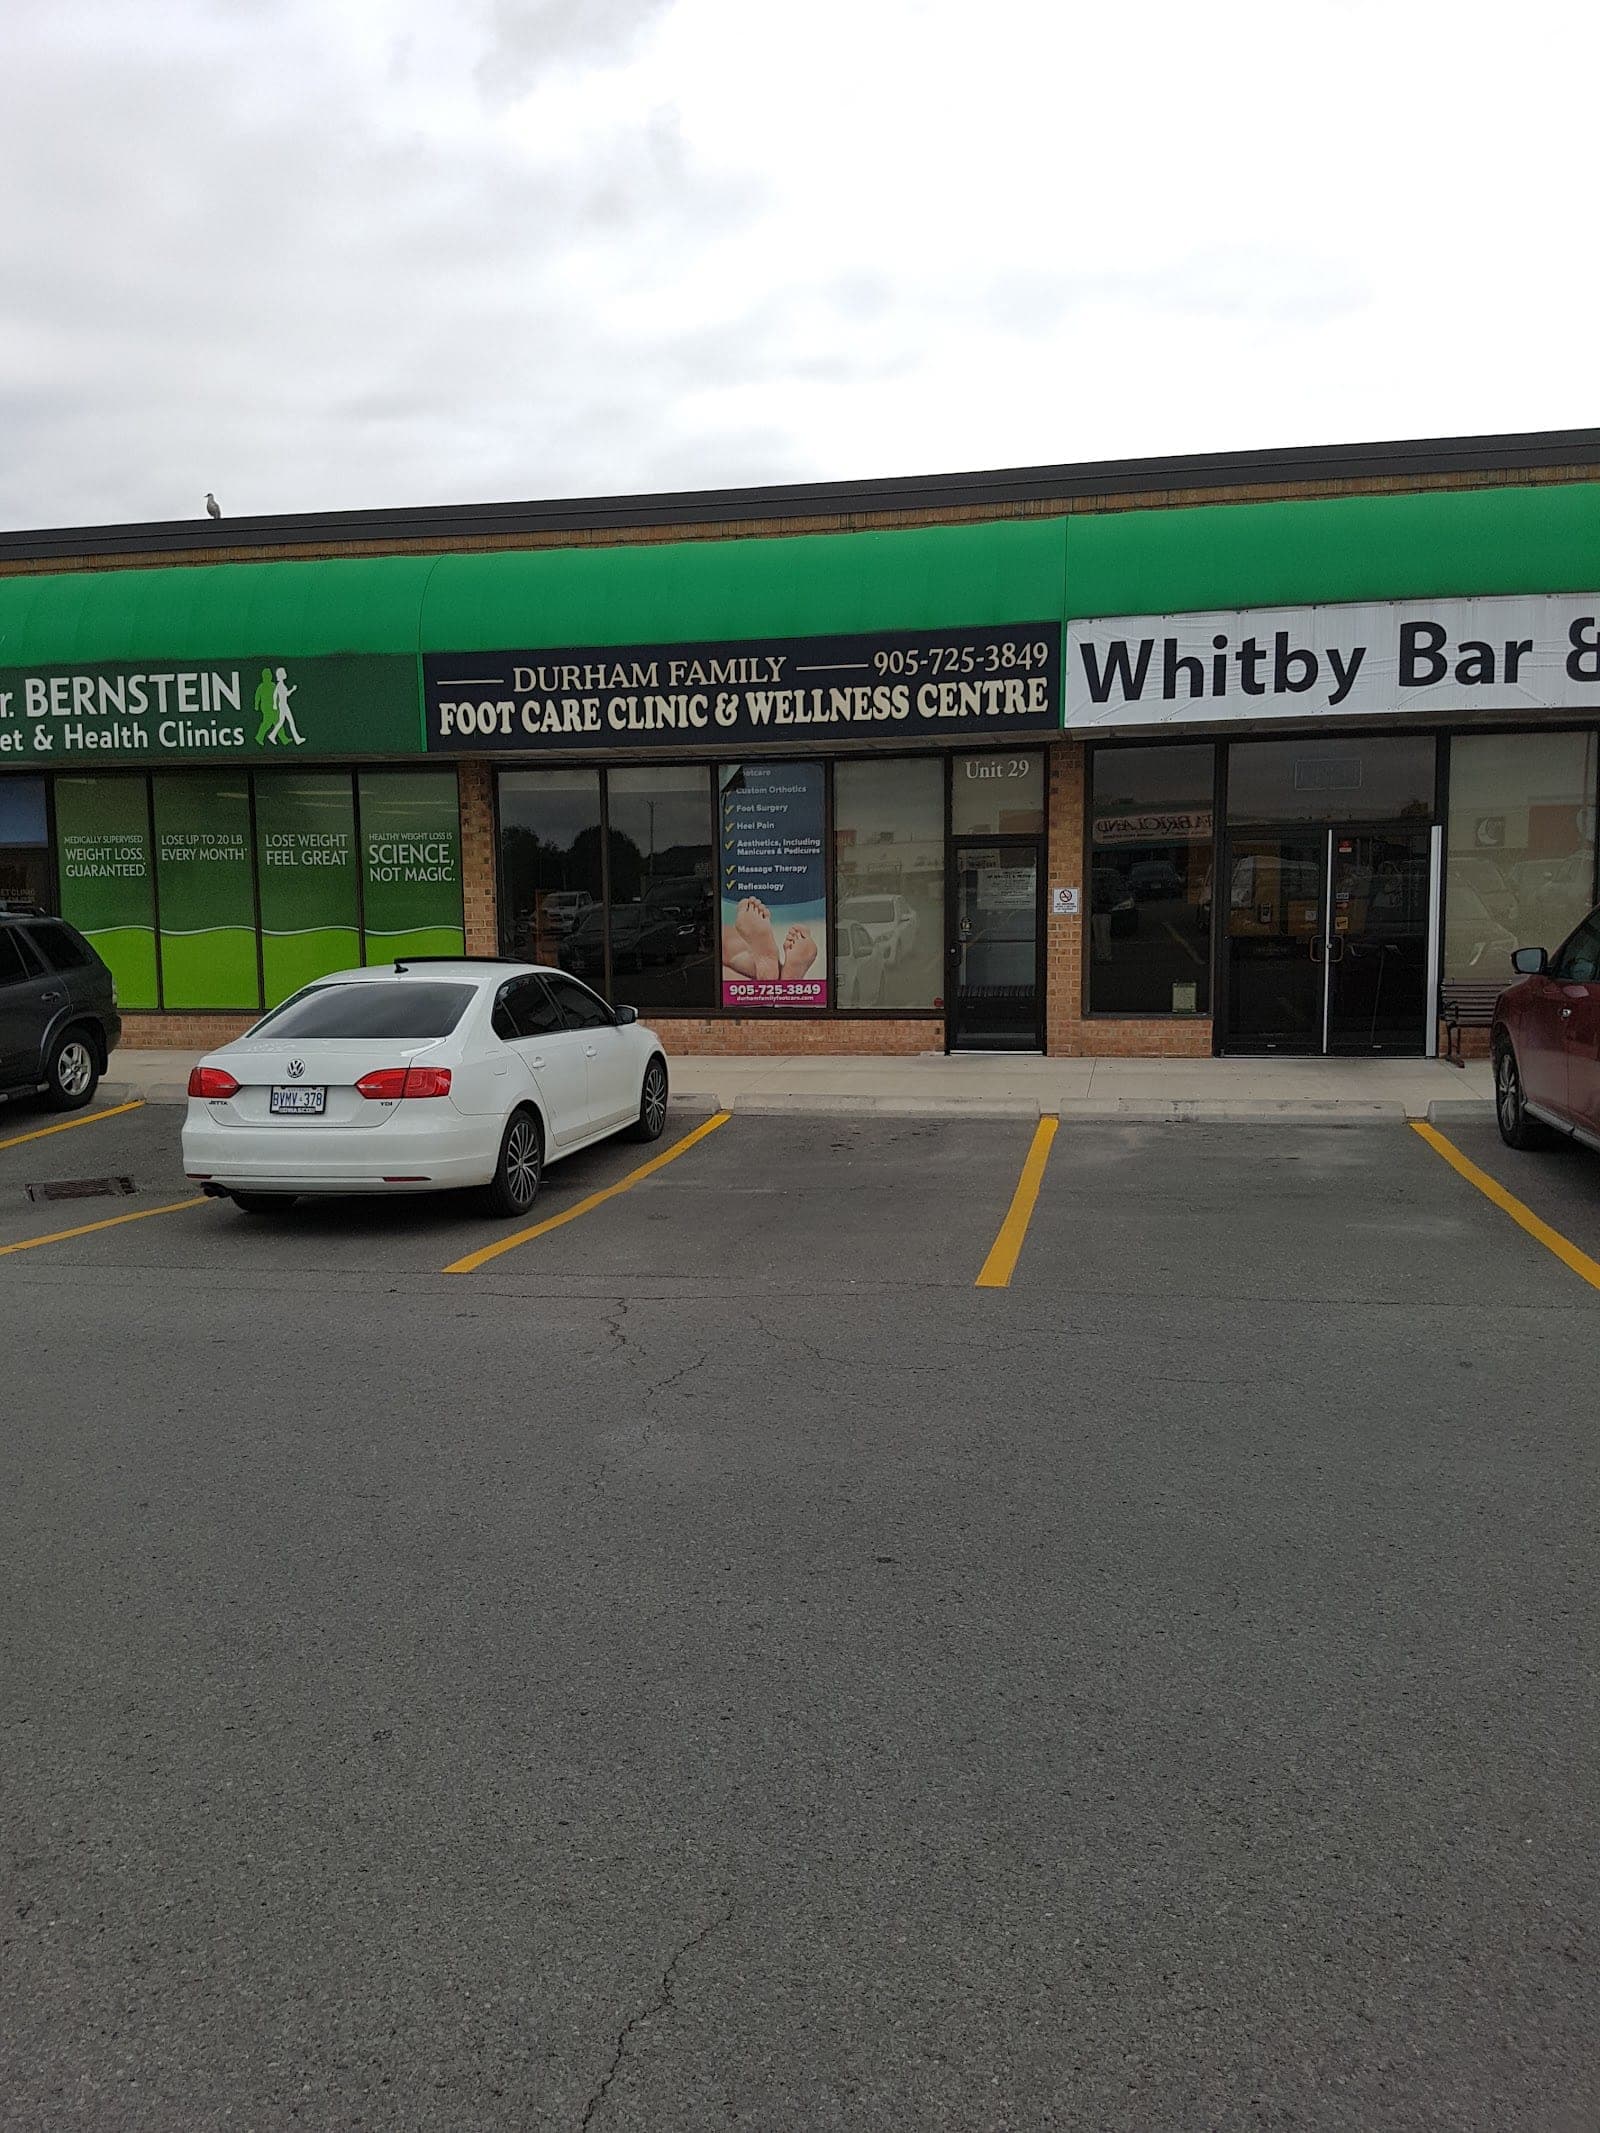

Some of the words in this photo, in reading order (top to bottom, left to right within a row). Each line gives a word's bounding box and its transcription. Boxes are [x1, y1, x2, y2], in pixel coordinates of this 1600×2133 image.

[513, 662, 659, 692] DURHAM
[668, 656, 787, 687] FAMILY
[874, 642, 1048, 676] 905-725-3849
[1080, 631, 1366, 705] Whitby
[1399, 621, 1532, 687] Bar
[1566, 617, 1600, 682] &
[0, 692, 14, 718] r.
[25, 671, 241, 718] BERNSTEIN
[439, 700, 515, 735] FOOT
[521, 698, 601, 733] CARE
[607, 693, 708, 730] CLINIC
[715, 692, 739, 726] &
[745, 684, 910, 726] WELLNESS
[916, 677, 1049, 718] CENTRE
[0, 730, 24, 752] et
[34, 724, 53, 751] &
[65, 721, 148, 749] Health
[158, 720, 244, 748] Clinics
[965, 761, 1004, 779] Unit
[1007, 760, 1030, 779] 29
[769, 784, 807, 794] Orthotics
[736, 804, 755, 813] Foot
[756, 804, 788, 813] Surgery
[737, 821, 755, 830] Heel
[756, 820, 775, 830] Pain
[64, 835, 101, 845] MEDICALLY
[102, 835, 143, 844] SUPERVISED
[161, 834, 185, 845] LOSE
[186, 834, 200, 845] UP
[201, 834, 215, 845] TO
[216, 834, 230, 845] 20
[231, 834, 243, 845] LB
[266, 834, 296, 847] LOSE
[297, 834, 348, 847] WEIGHT
[368, 832, 400, 841] HEALTHY
[401, 831, 428, 841] WEIGHT
[429, 831, 446, 840] LOSS
[447, 831, 453, 840] IS
[65, 848, 112, 861] WEIGHT
[114, 847, 145, 860] LOSS.
[162, 848, 197, 861] EVERY
[266, 850, 299, 866] FEEL
[302, 849, 348, 866] GREAT
[369, 843, 455, 867] SCIENCE,
[369, 866, 401, 882] NOT
[404, 866, 456, 882] MAGIC.
[737, 865, 773, 874] Massage
[774, 864, 808, 874] Therapy
[737, 882, 785, 892] Reflexology
[729, 984, 821, 996] 905-725-3849
